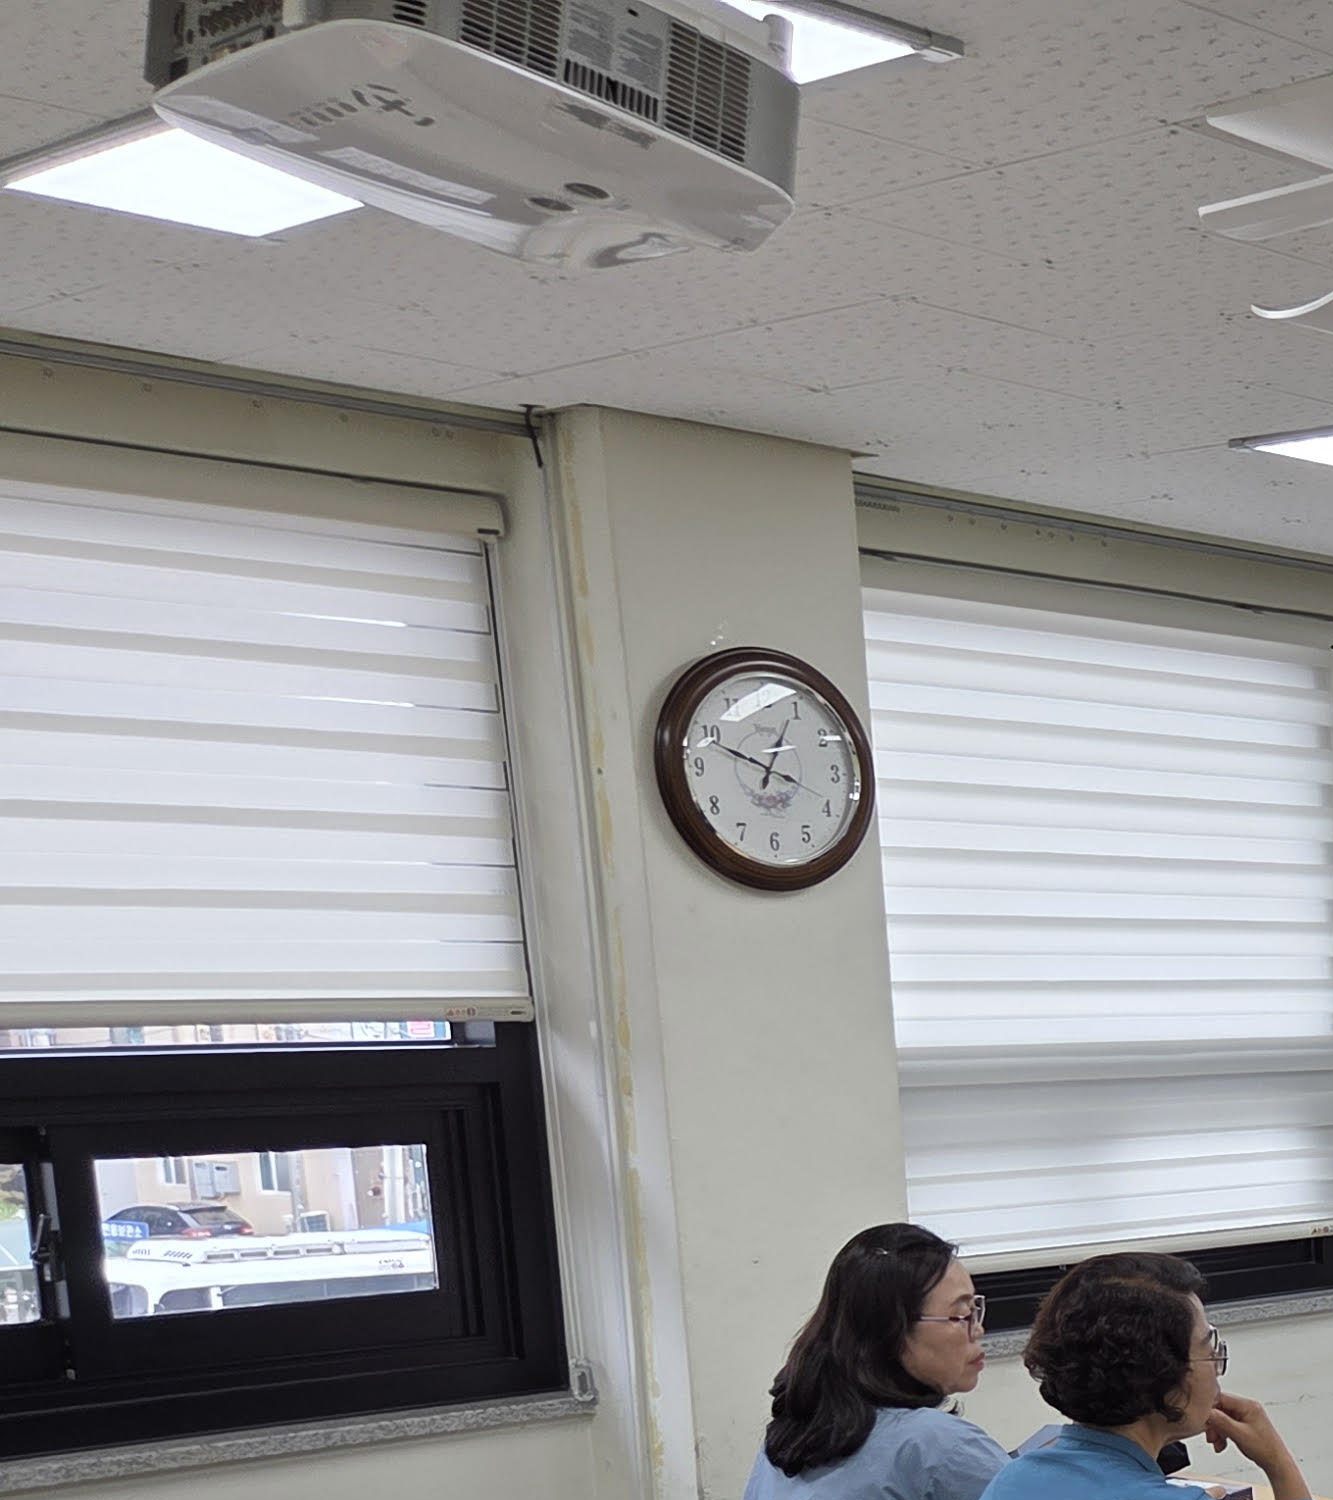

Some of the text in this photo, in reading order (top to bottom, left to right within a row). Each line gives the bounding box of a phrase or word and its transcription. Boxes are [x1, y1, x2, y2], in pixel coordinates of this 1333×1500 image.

[791, 701, 801, 720] 1
[694, 757, 705, 777] 9
[830, 765, 840, 783] 3
[709, 795, 720, 815] 8
[822, 799, 832, 817] 4
[736, 822, 747, 841] 7
[801, 825, 811, 843] 5
[769, 832, 780, 851] 6
